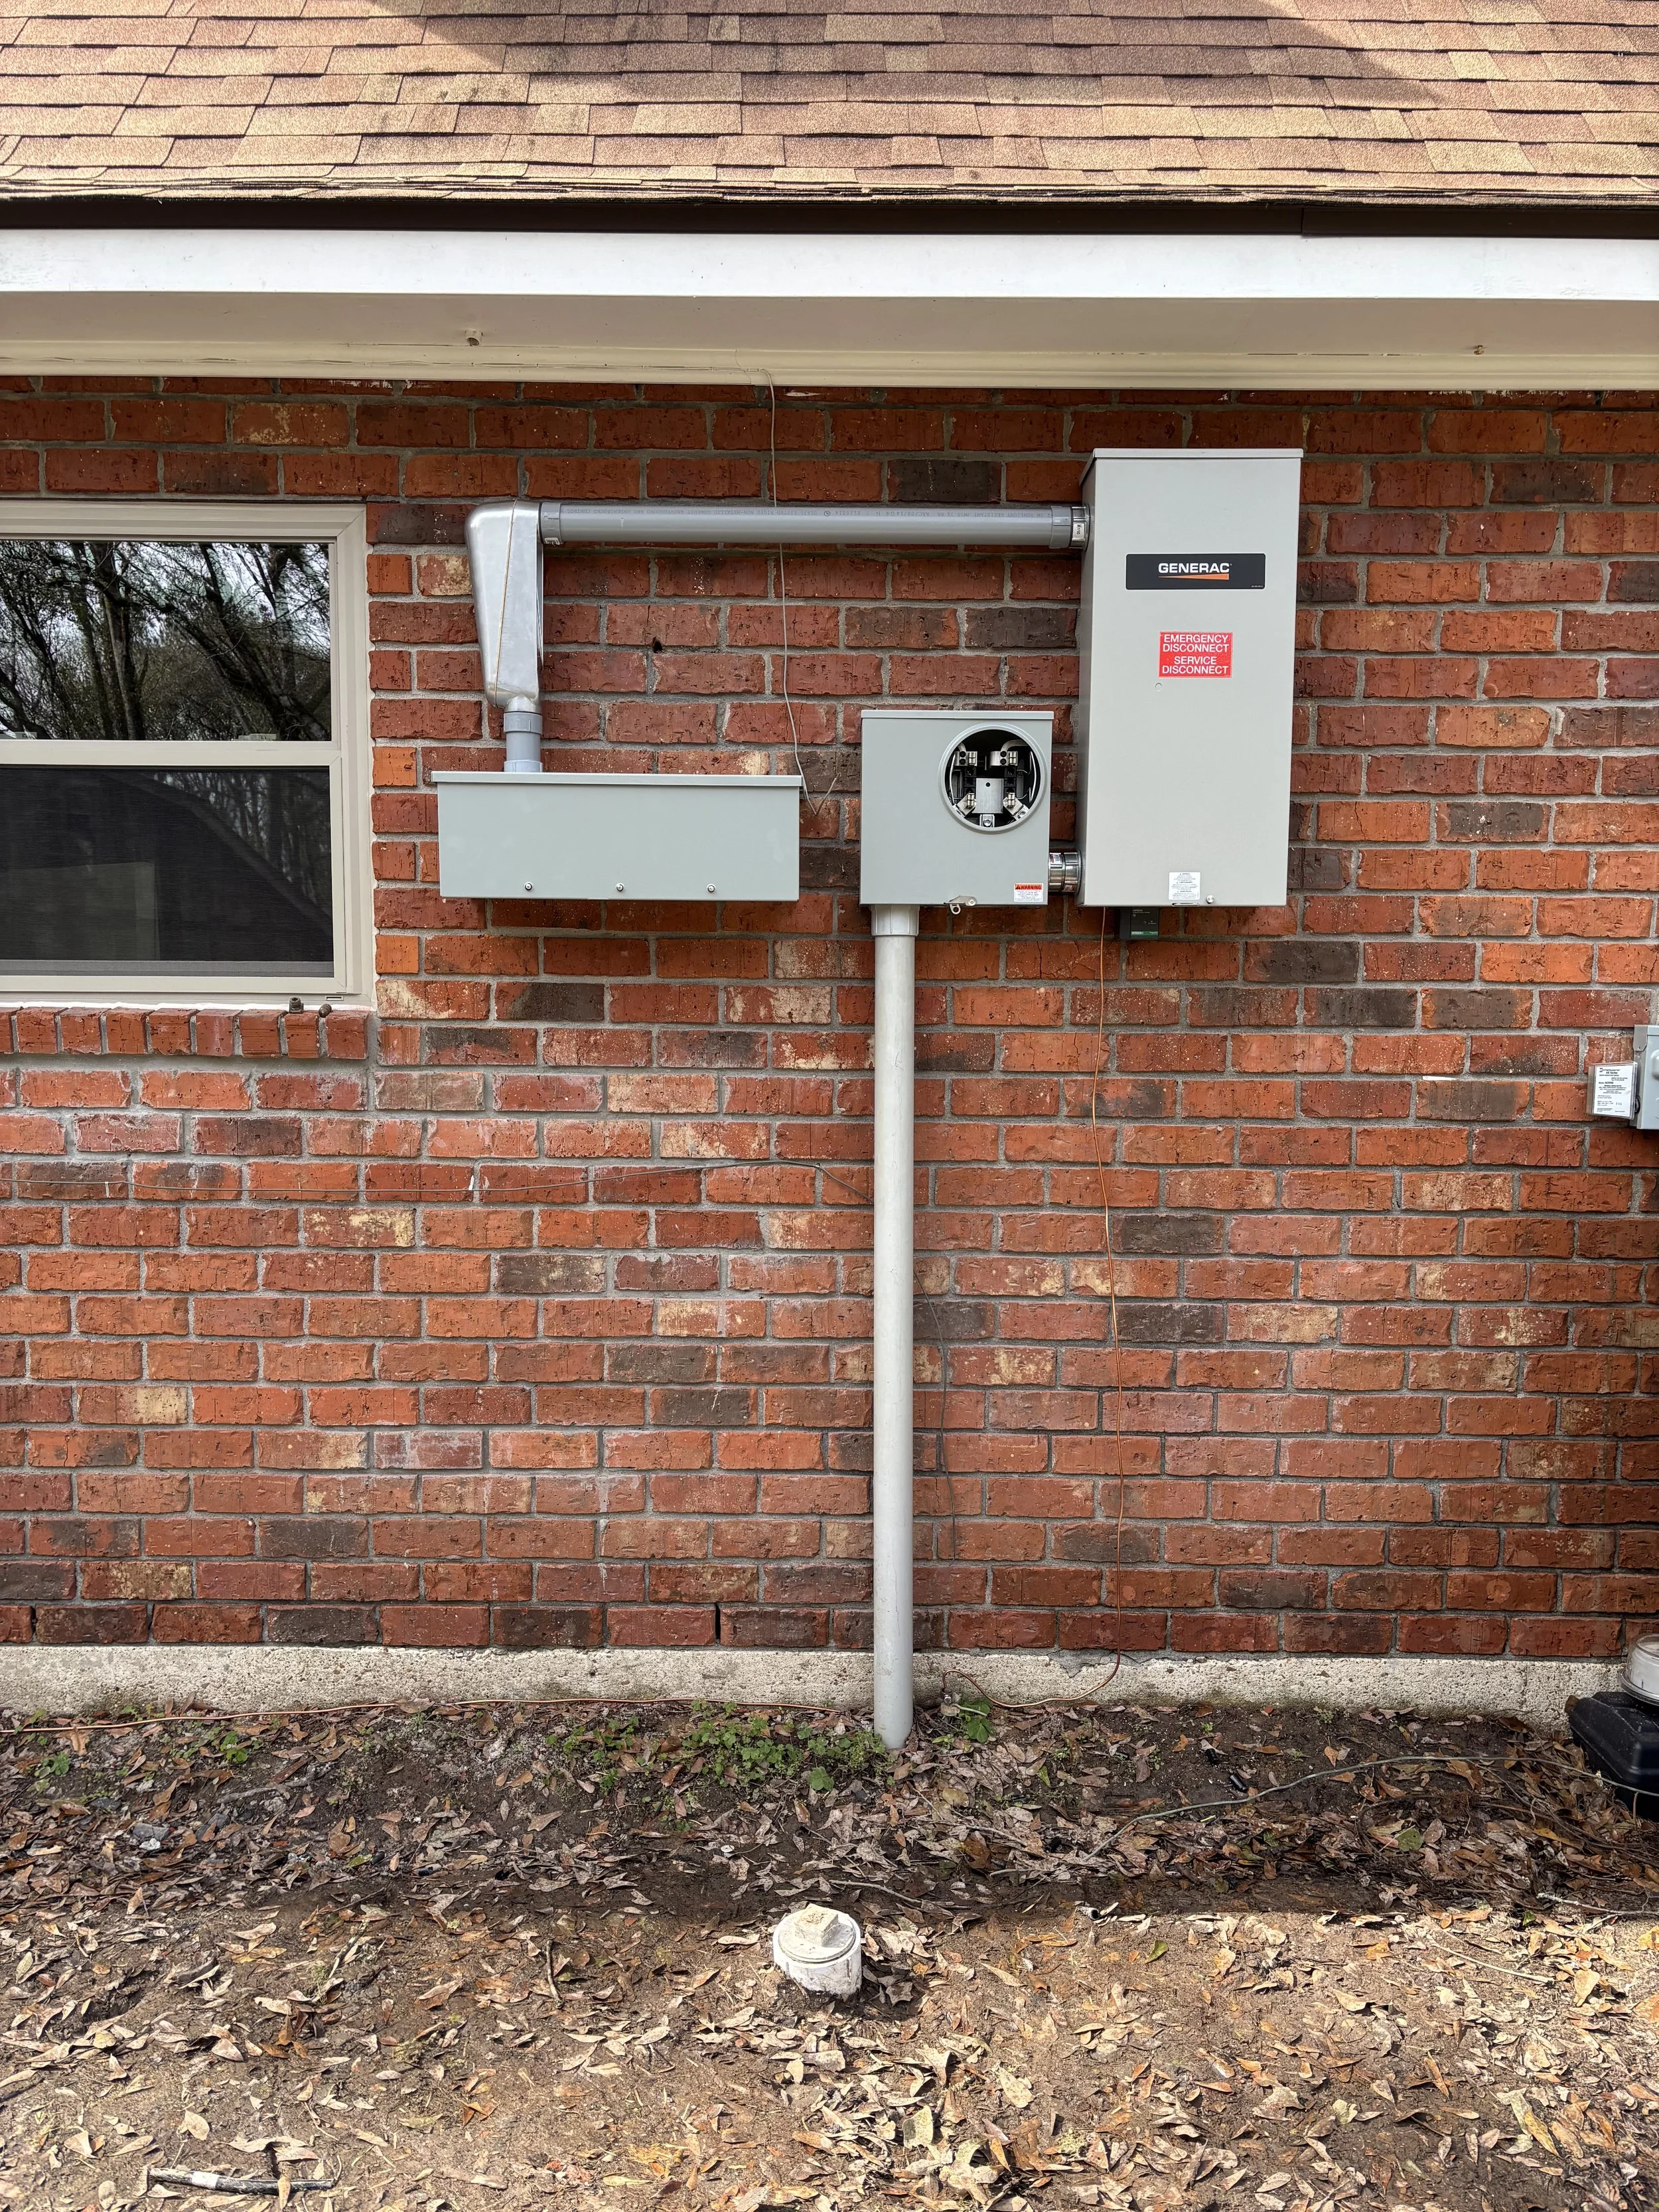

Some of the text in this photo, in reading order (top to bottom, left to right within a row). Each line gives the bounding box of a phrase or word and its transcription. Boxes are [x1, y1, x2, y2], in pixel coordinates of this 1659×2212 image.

[1158, 563, 1230, 573] GENERAC
[1163, 634, 1228, 643] EMERGENCY
[1163, 644, 1229, 652] DISCONNECT
[1174, 656, 1217, 665] SERVICE
[1162, 665, 1229, 674] DISCONNECT
